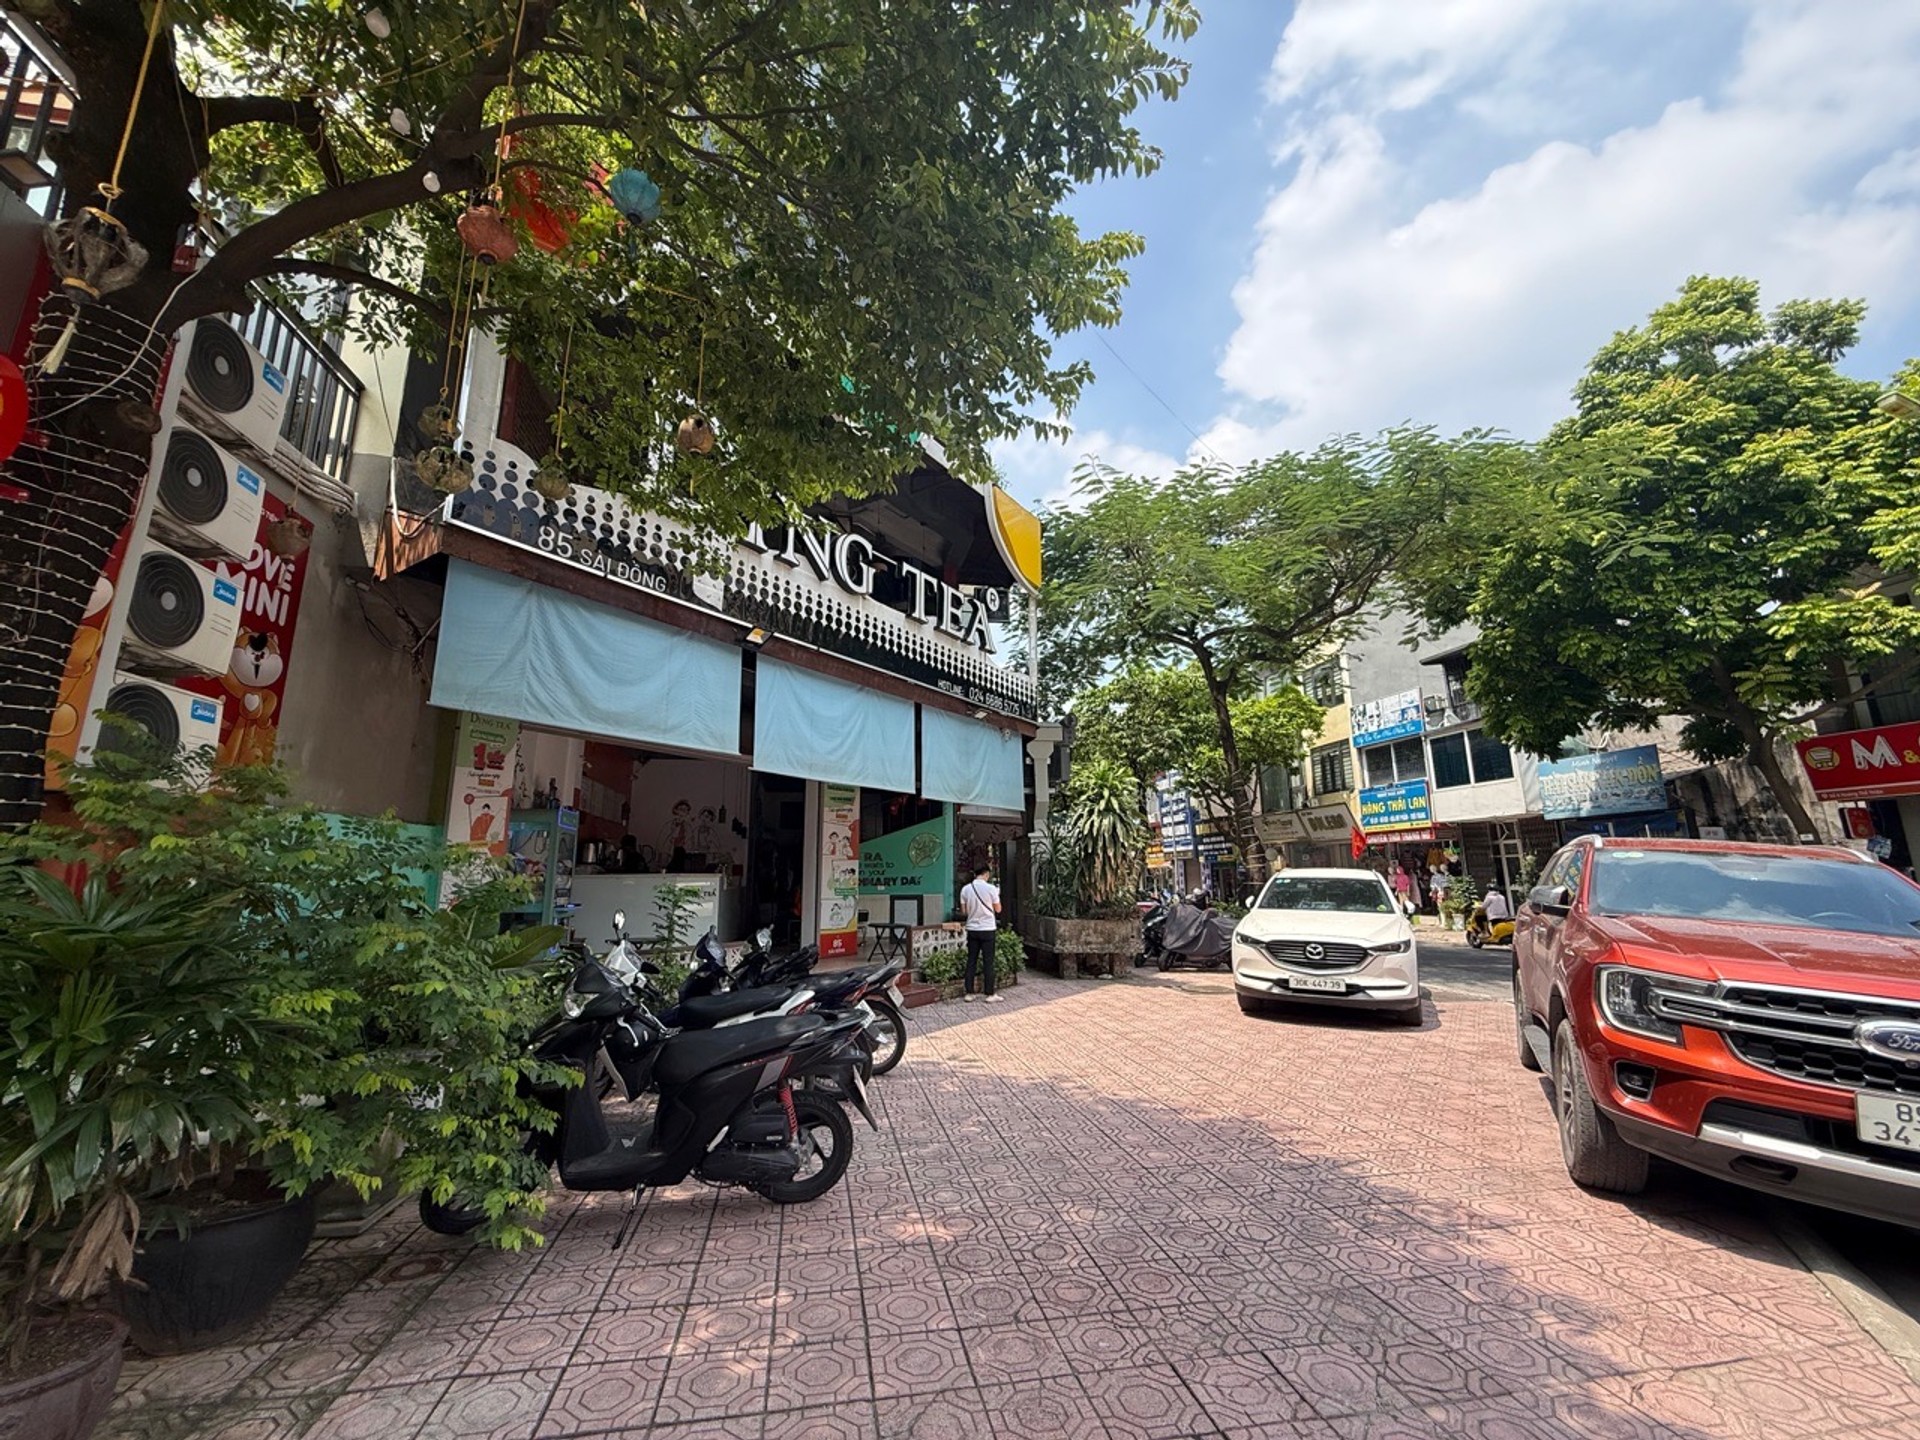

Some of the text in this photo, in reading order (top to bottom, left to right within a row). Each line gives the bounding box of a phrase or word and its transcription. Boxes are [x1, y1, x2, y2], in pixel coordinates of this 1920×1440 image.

[242, 541, 296, 592] OVE
[538, 525, 668, 593] 85 SÀI ĐỒNG
[742, 513, 876, 595] ING
[1851, 734, 1902, 770] M
[1362, 796, 1426, 816] HÀNG THÁI LAN
[1888, 1032, 1920, 1051] For
